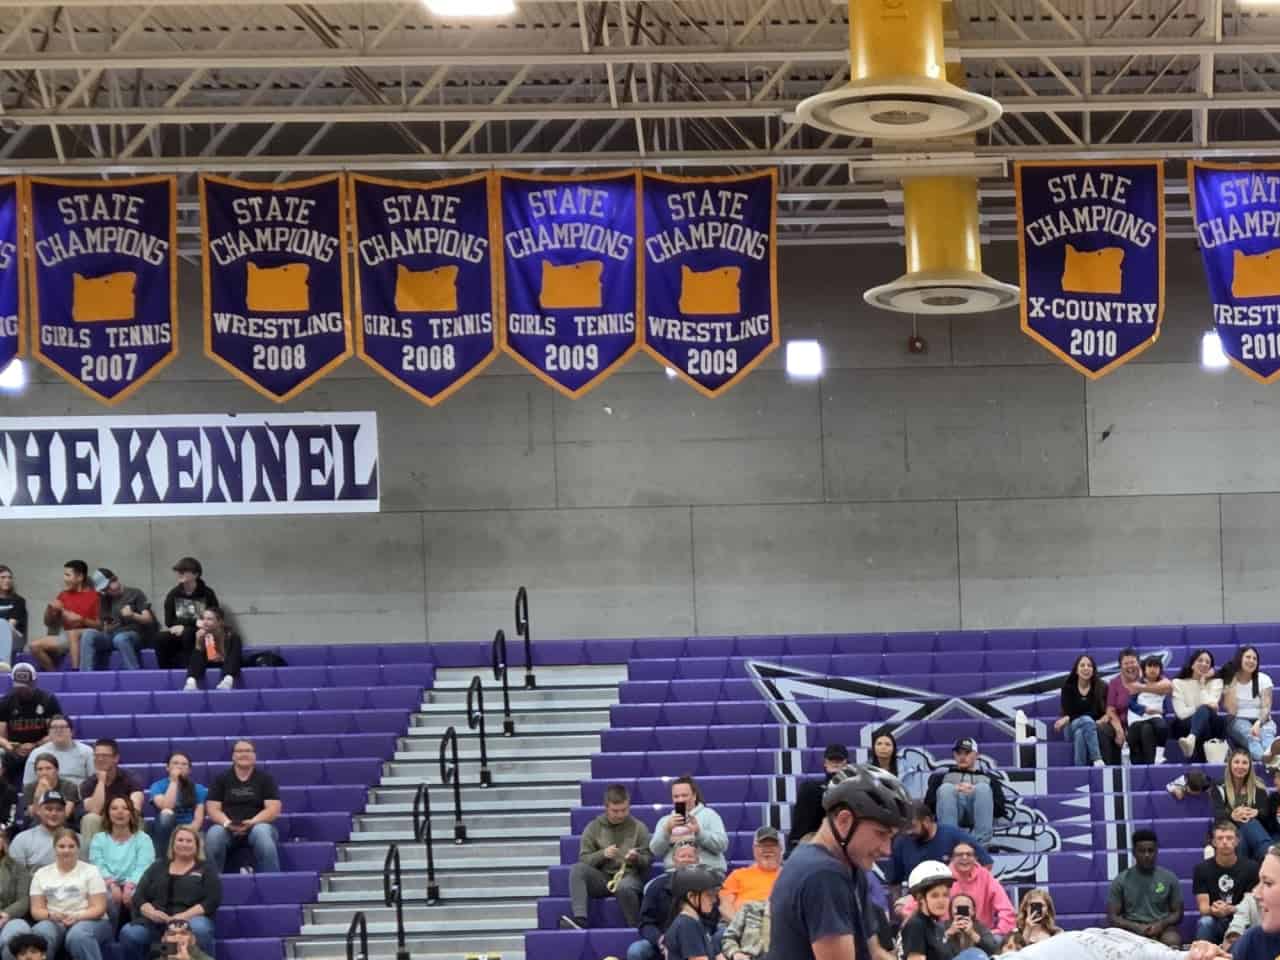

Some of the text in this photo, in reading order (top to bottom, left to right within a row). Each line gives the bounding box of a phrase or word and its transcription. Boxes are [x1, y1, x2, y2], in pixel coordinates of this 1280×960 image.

[528, 187, 608, 217] STATE
[1048, 173, 1131, 204] STATE
[58, 194, 144, 225] STATE
[232, 197, 315, 225] STATE
[384, 195, 460, 225] STATE
[667, 190, 748, 220] STATE
[1026, 206, 1157, 248] CHAMPIONS
[35, 227, 169, 267] CHAMPIONS
[209, 229, 340, 267] CHAMPIONS
[358, 227, 488, 266] CHAMPIONS
[505, 223, 633, 261] CHAMPIONS
[645, 224, 769, 263] CHAMPIONS
[364, 312, 492, 338] GIRLS TENNIS
[508, 311, 635, 337] GIRLS TENNIS
[1029, 297, 1157, 324] X-COUNTRY
[42, 326, 90, 348] GIRLS
[105, 323, 172, 347] TENNIS
[213, 312, 343, 339] WRESTLING
[648, 314, 769, 342] WRESTLING
[253, 345, 306, 370] 2008
[545, 344, 599, 371] 2009
[1070, 329, 1117, 357] 2010
[80, 353, 137, 382] 2007
[402, 345, 455, 371] 2008
[687, 350, 737, 375] 2009
[0, 424, 378, 506] HE KENNEL
